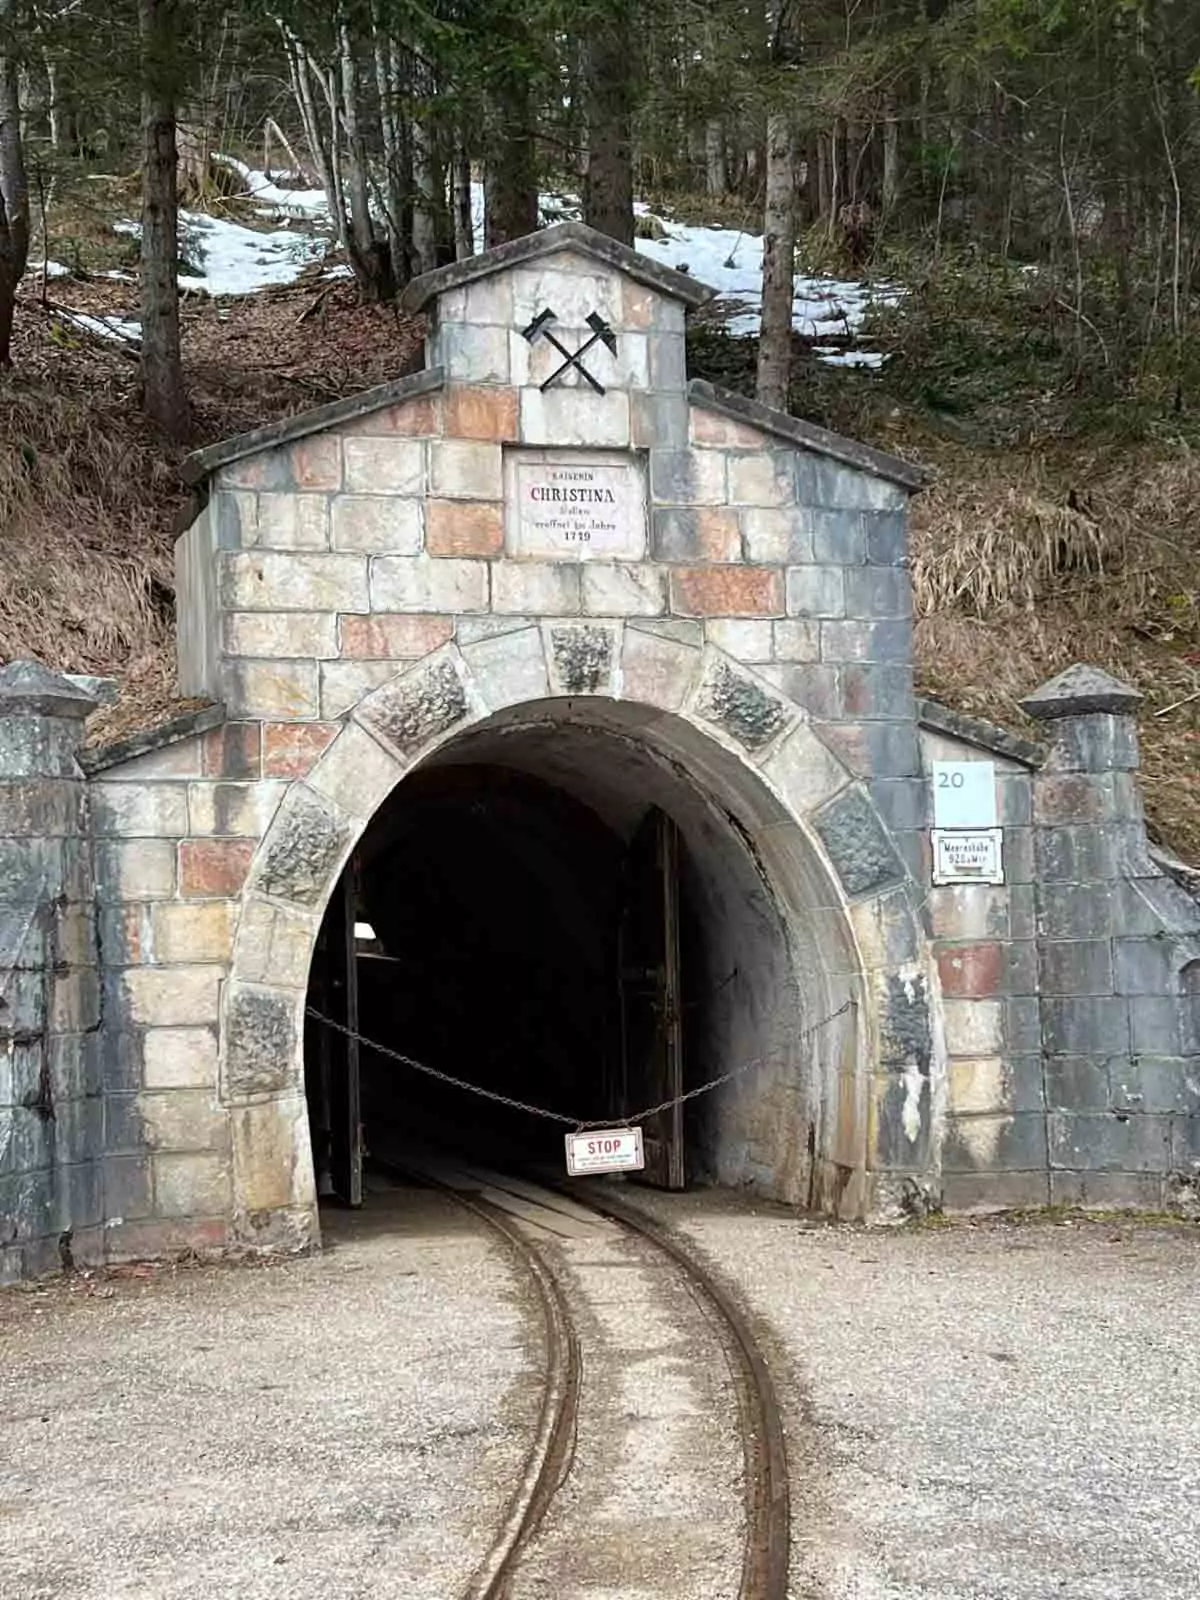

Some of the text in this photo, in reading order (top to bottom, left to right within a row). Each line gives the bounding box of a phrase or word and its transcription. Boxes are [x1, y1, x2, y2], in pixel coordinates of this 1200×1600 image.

[530, 487, 615, 503] CHRISTINA
[938, 772, 964, 788] 20
[587, 1139, 621, 1154] STOP
